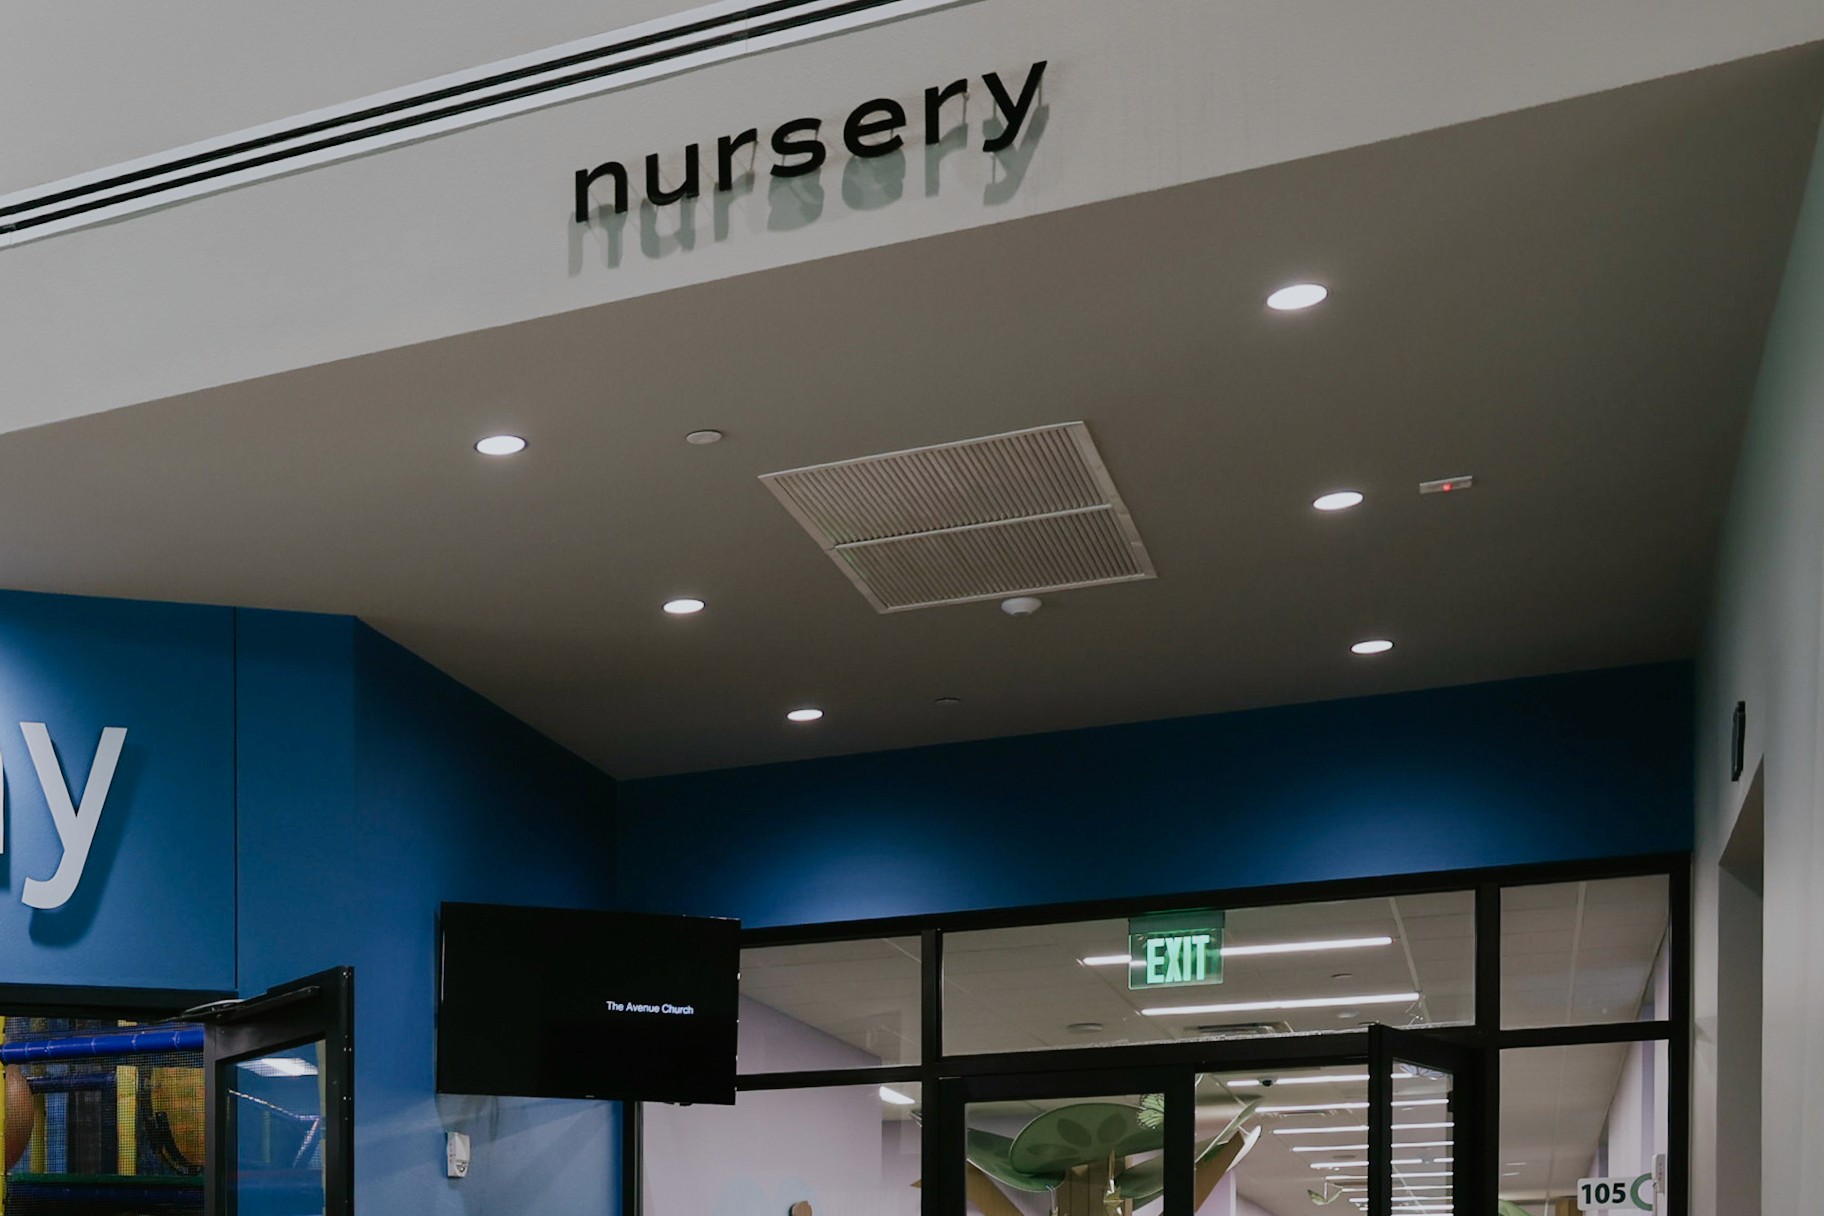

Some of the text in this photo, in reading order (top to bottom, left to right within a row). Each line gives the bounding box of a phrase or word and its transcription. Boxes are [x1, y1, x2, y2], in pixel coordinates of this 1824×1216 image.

[575, 60, 1048, 223] nursery
[1146, 934, 1210, 984] EXIT
[606, 1000, 694, 1015] The Avenue Church
[1581, 1183, 1626, 1204] 105
